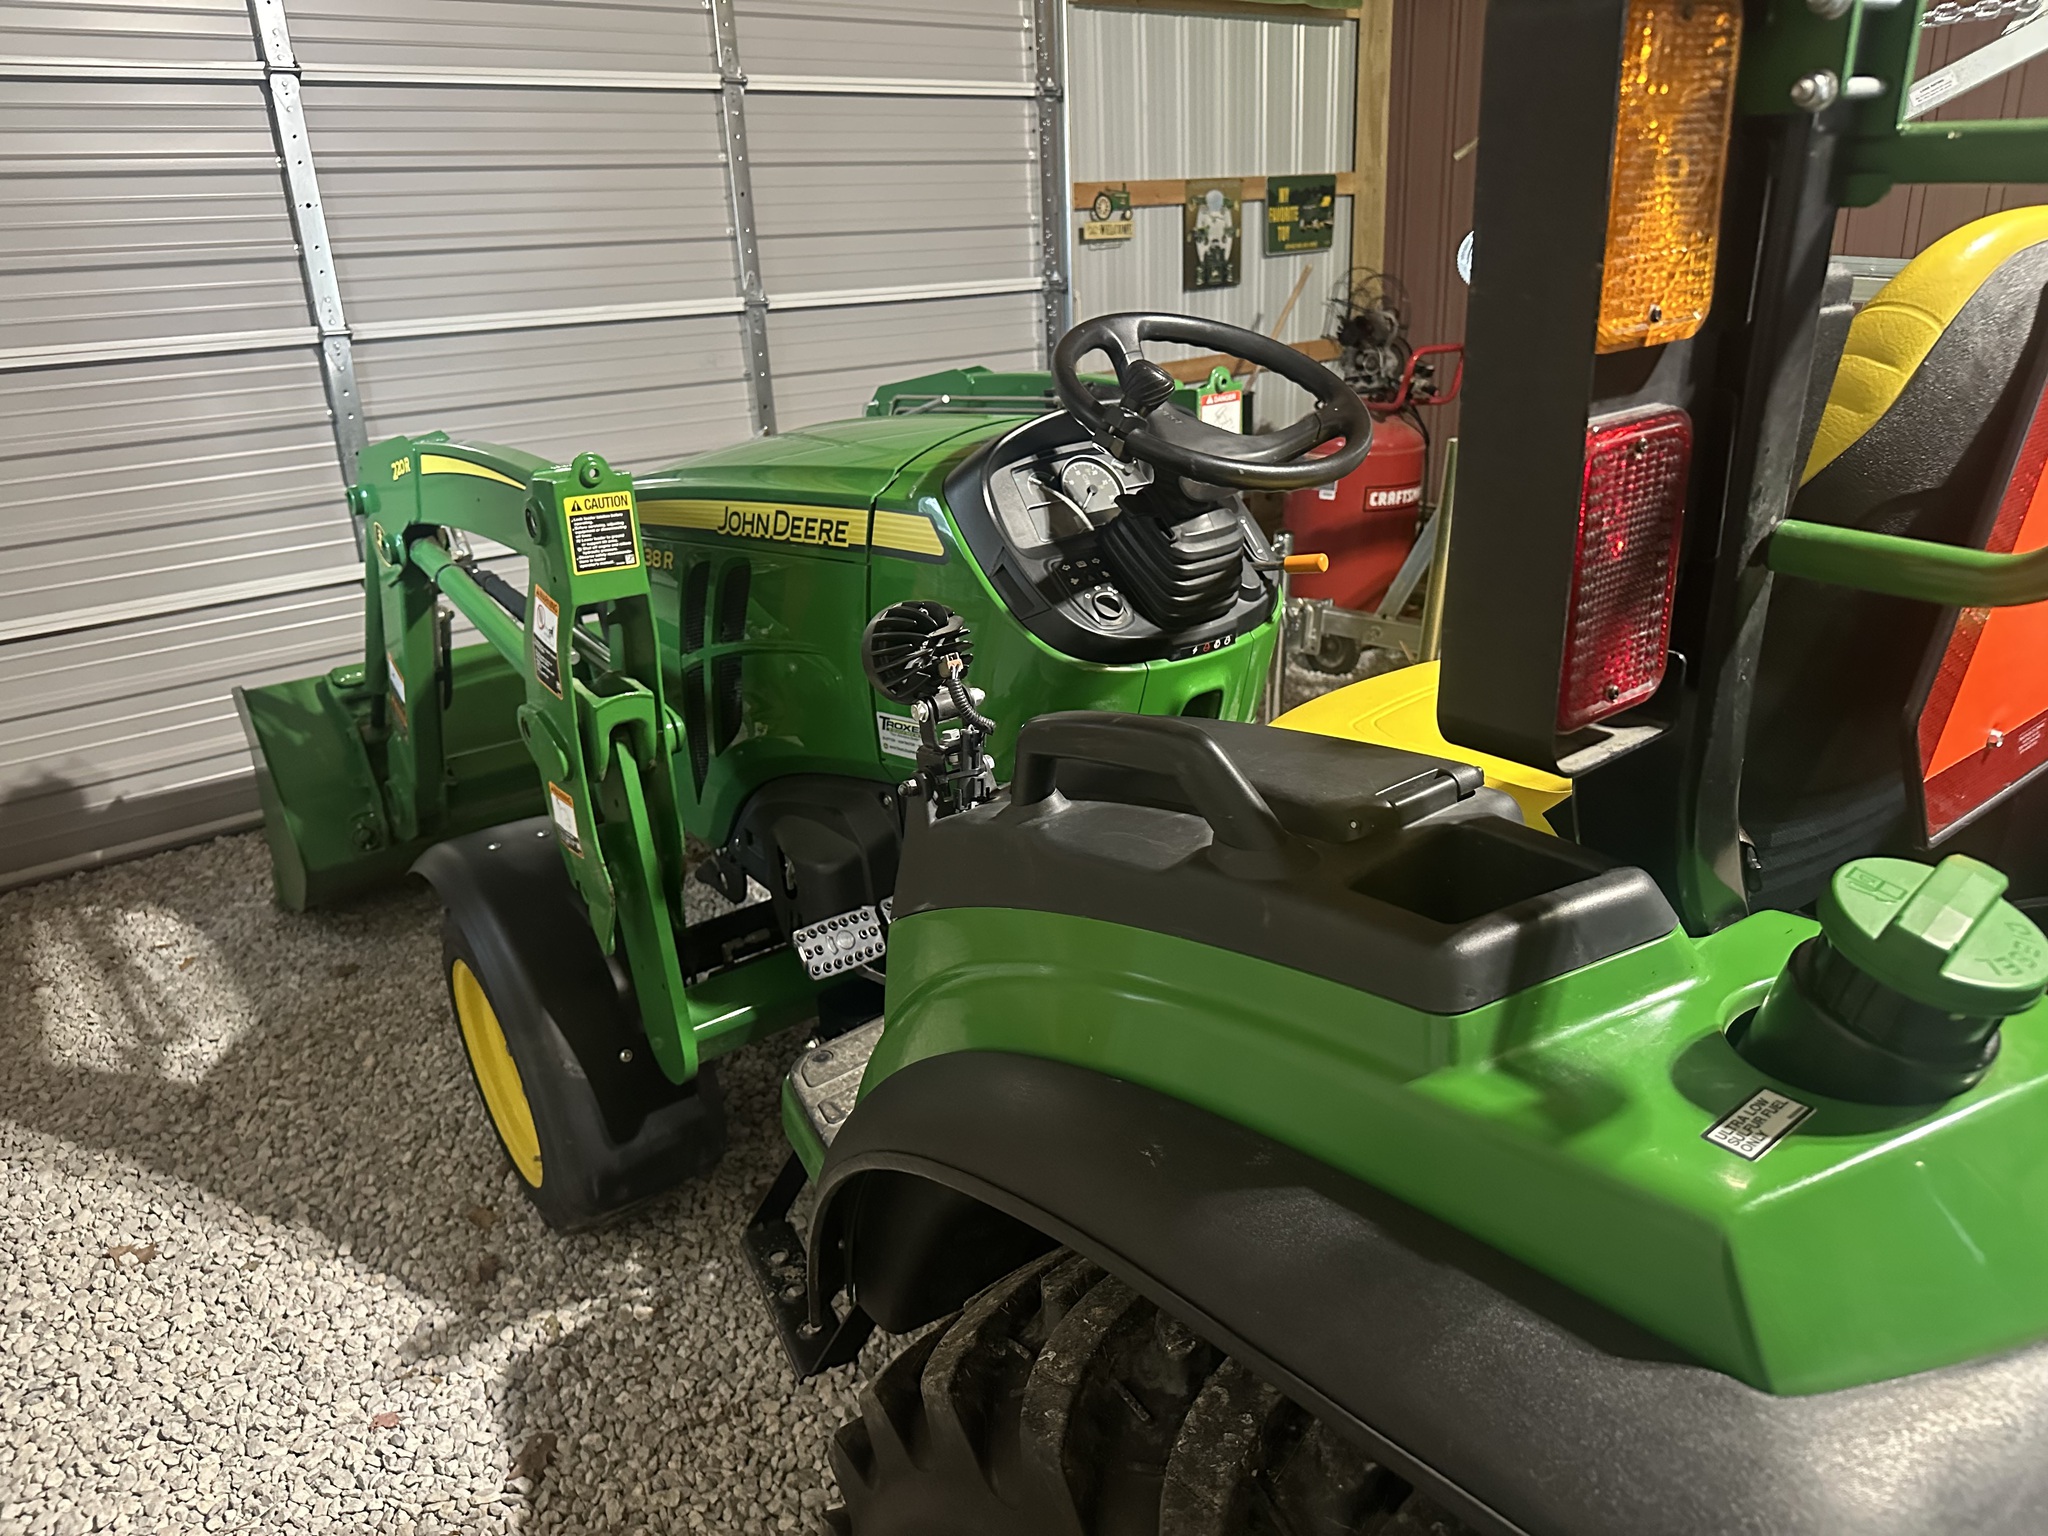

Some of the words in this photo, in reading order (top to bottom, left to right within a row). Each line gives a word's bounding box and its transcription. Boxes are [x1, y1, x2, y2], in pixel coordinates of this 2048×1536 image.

[584, 495, 628, 511] CAUTION
[717, 506, 770, 536] JOHN
[773, 510, 850, 544] DEERE
[1714, 1114, 1750, 1141] ULTRA
[1743, 1097, 1769, 1117] LOW
[1727, 1115, 1766, 1147] SULFUR
[1761, 1099, 1789, 1119] FUEL
[1740, 1129, 1769, 1152] ONLY
